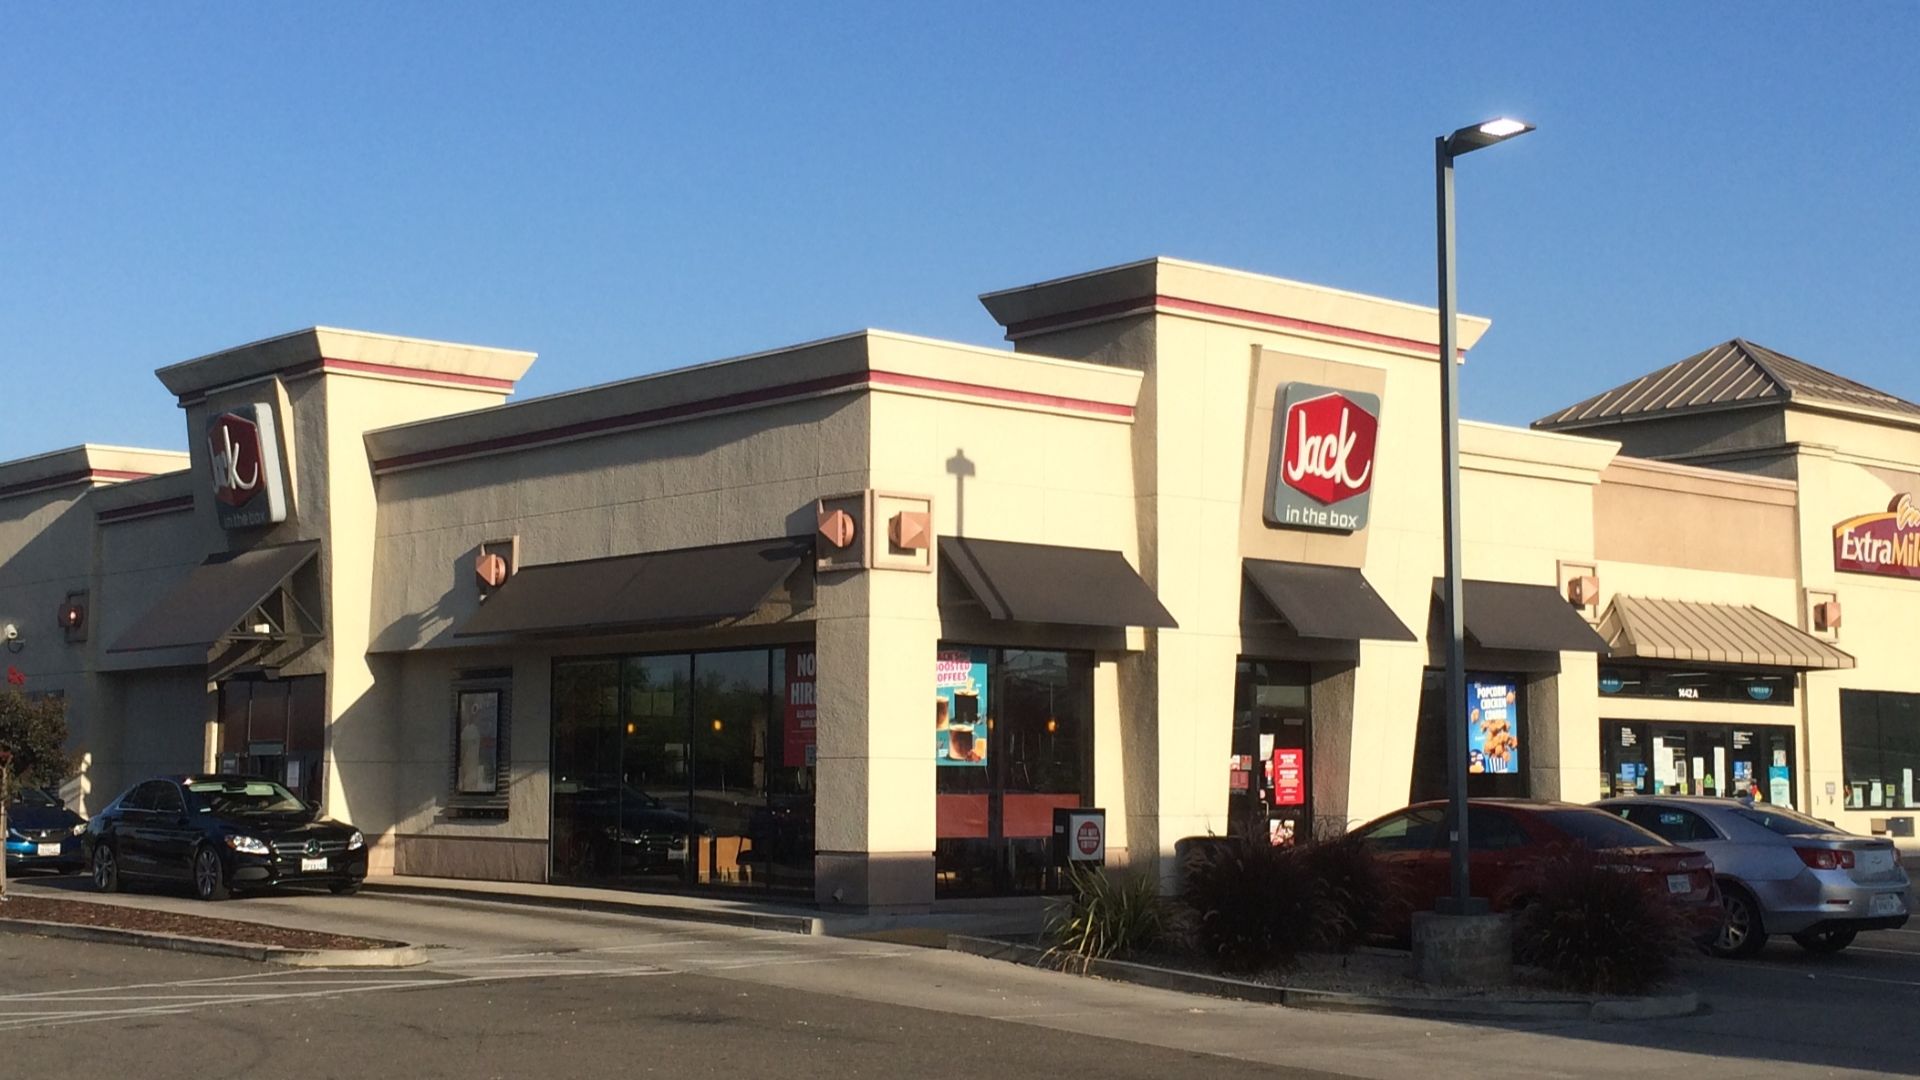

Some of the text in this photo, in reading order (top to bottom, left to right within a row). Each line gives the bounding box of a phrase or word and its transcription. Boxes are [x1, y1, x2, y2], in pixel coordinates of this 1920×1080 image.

[1287, 407, 1371, 489] Jack
[1286, 505, 1359, 528] in the box
[1841, 528, 1920, 568] ExtraMil
[936, 659, 970, 671] OOSTED
[937, 672, 966, 682] OFFEES
[1477, 686, 1507, 699] POPCORN
